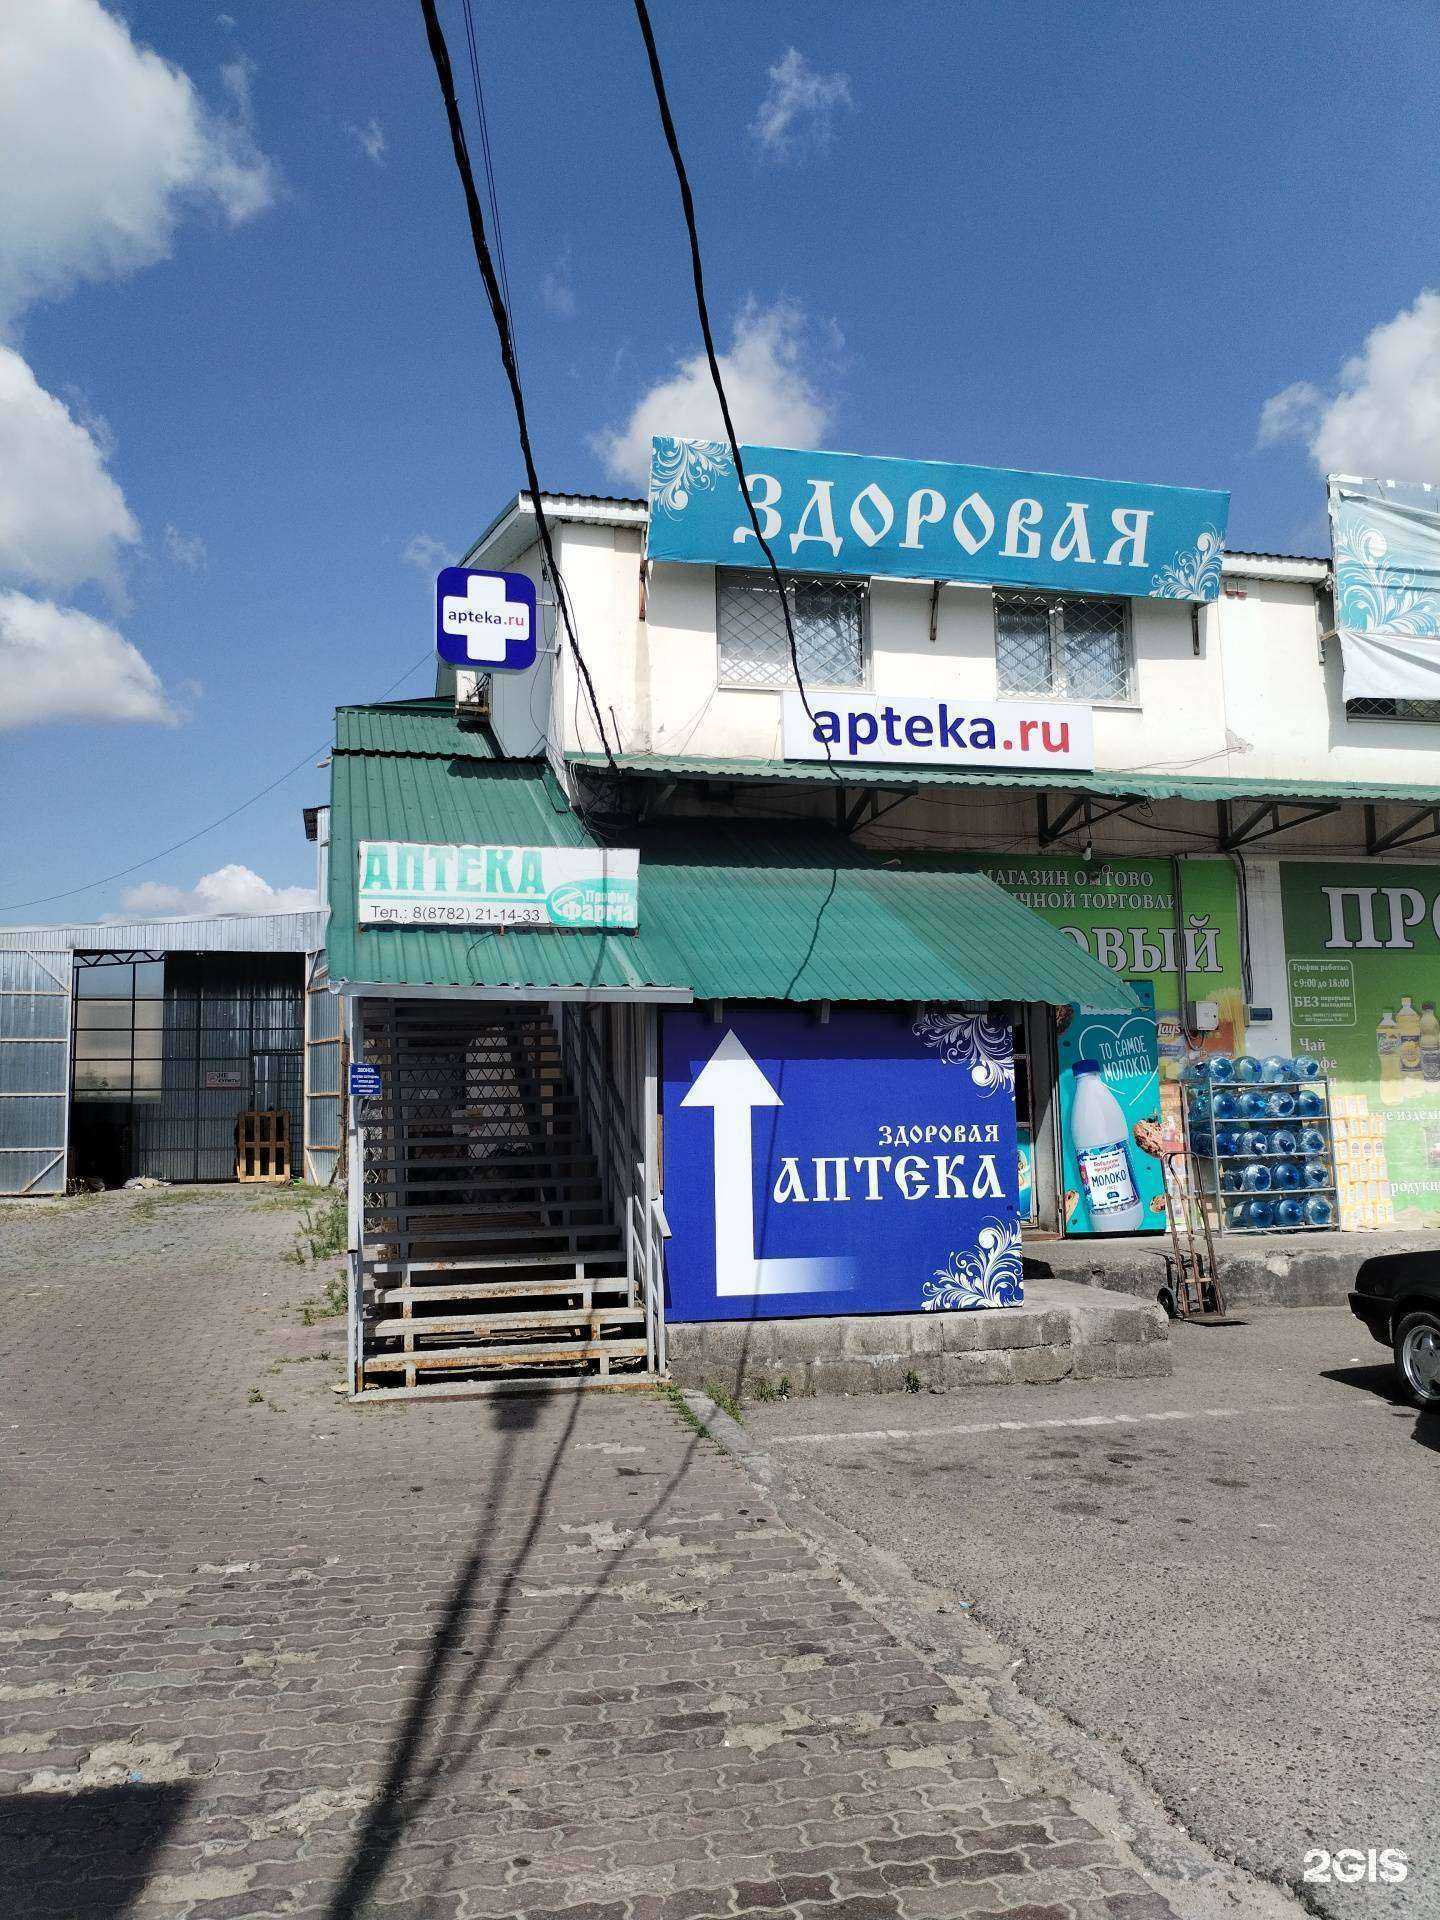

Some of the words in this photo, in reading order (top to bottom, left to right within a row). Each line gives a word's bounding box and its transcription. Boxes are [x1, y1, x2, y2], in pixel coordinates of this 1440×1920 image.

[733, 473, 1155, 568] ЗДОРОВАЯ
[448, 610, 524, 627] apteka.ru
[812, 703, 1070, 755] apteka.ru
[362, 845, 546, 894] АПТЕКА
[371, 905, 407, 919] Тел.:
[413, 906, 471, 921] 8(8782)
[475, 908, 541, 922] 21-14-33
[1321, 886, 1440, 948] ПР
[1299, 979, 1317, 988] 9:00
[1294, 996, 1319, 1007] БЕЗ
[1099, 1043, 1112, 1060] ТО
[1115, 1035, 1147, 1058] САМОЕ
[1320, 1056, 1337, 1073] фе
[878, 1124, 1000, 1147] ЗДОРОВАЯ
[773, 1154, 1006, 1203] АПТЕКА
[1091, 1169, 1127, 1187] МОЛОКО
